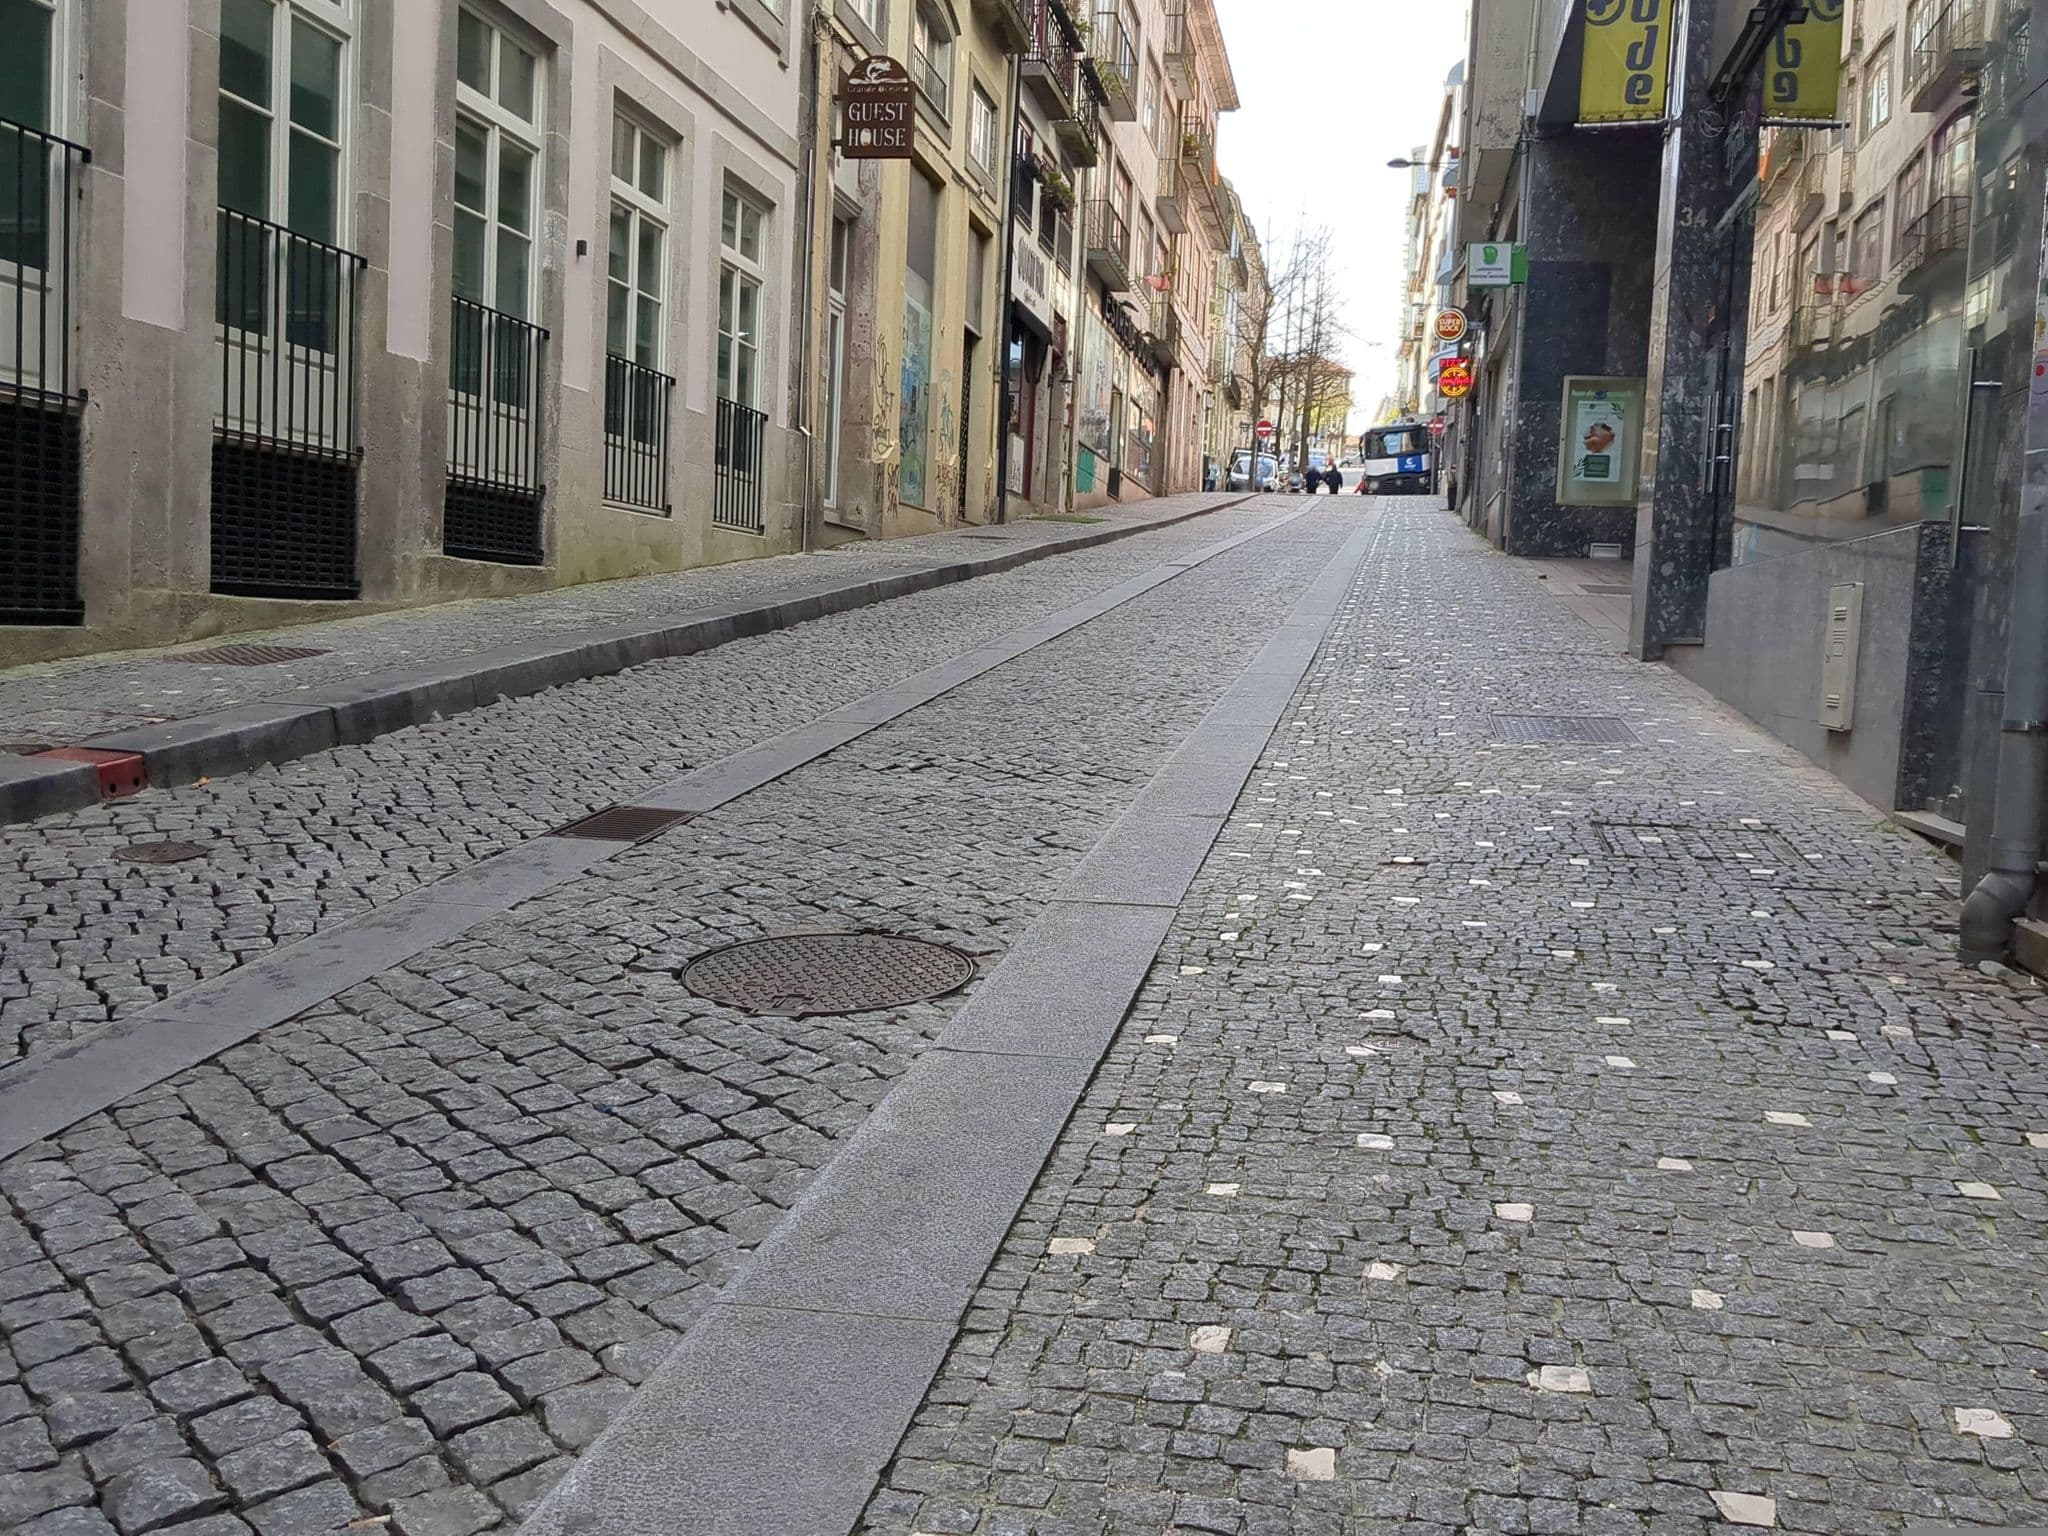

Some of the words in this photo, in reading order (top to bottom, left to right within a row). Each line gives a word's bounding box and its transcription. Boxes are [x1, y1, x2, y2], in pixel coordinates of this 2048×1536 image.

[849, 103, 907, 121] GUEST
[849, 128, 906, 146] HOUSE
[1438, 317, 1460, 325] SUPER
[1439, 324, 1459, 332] BOCK
